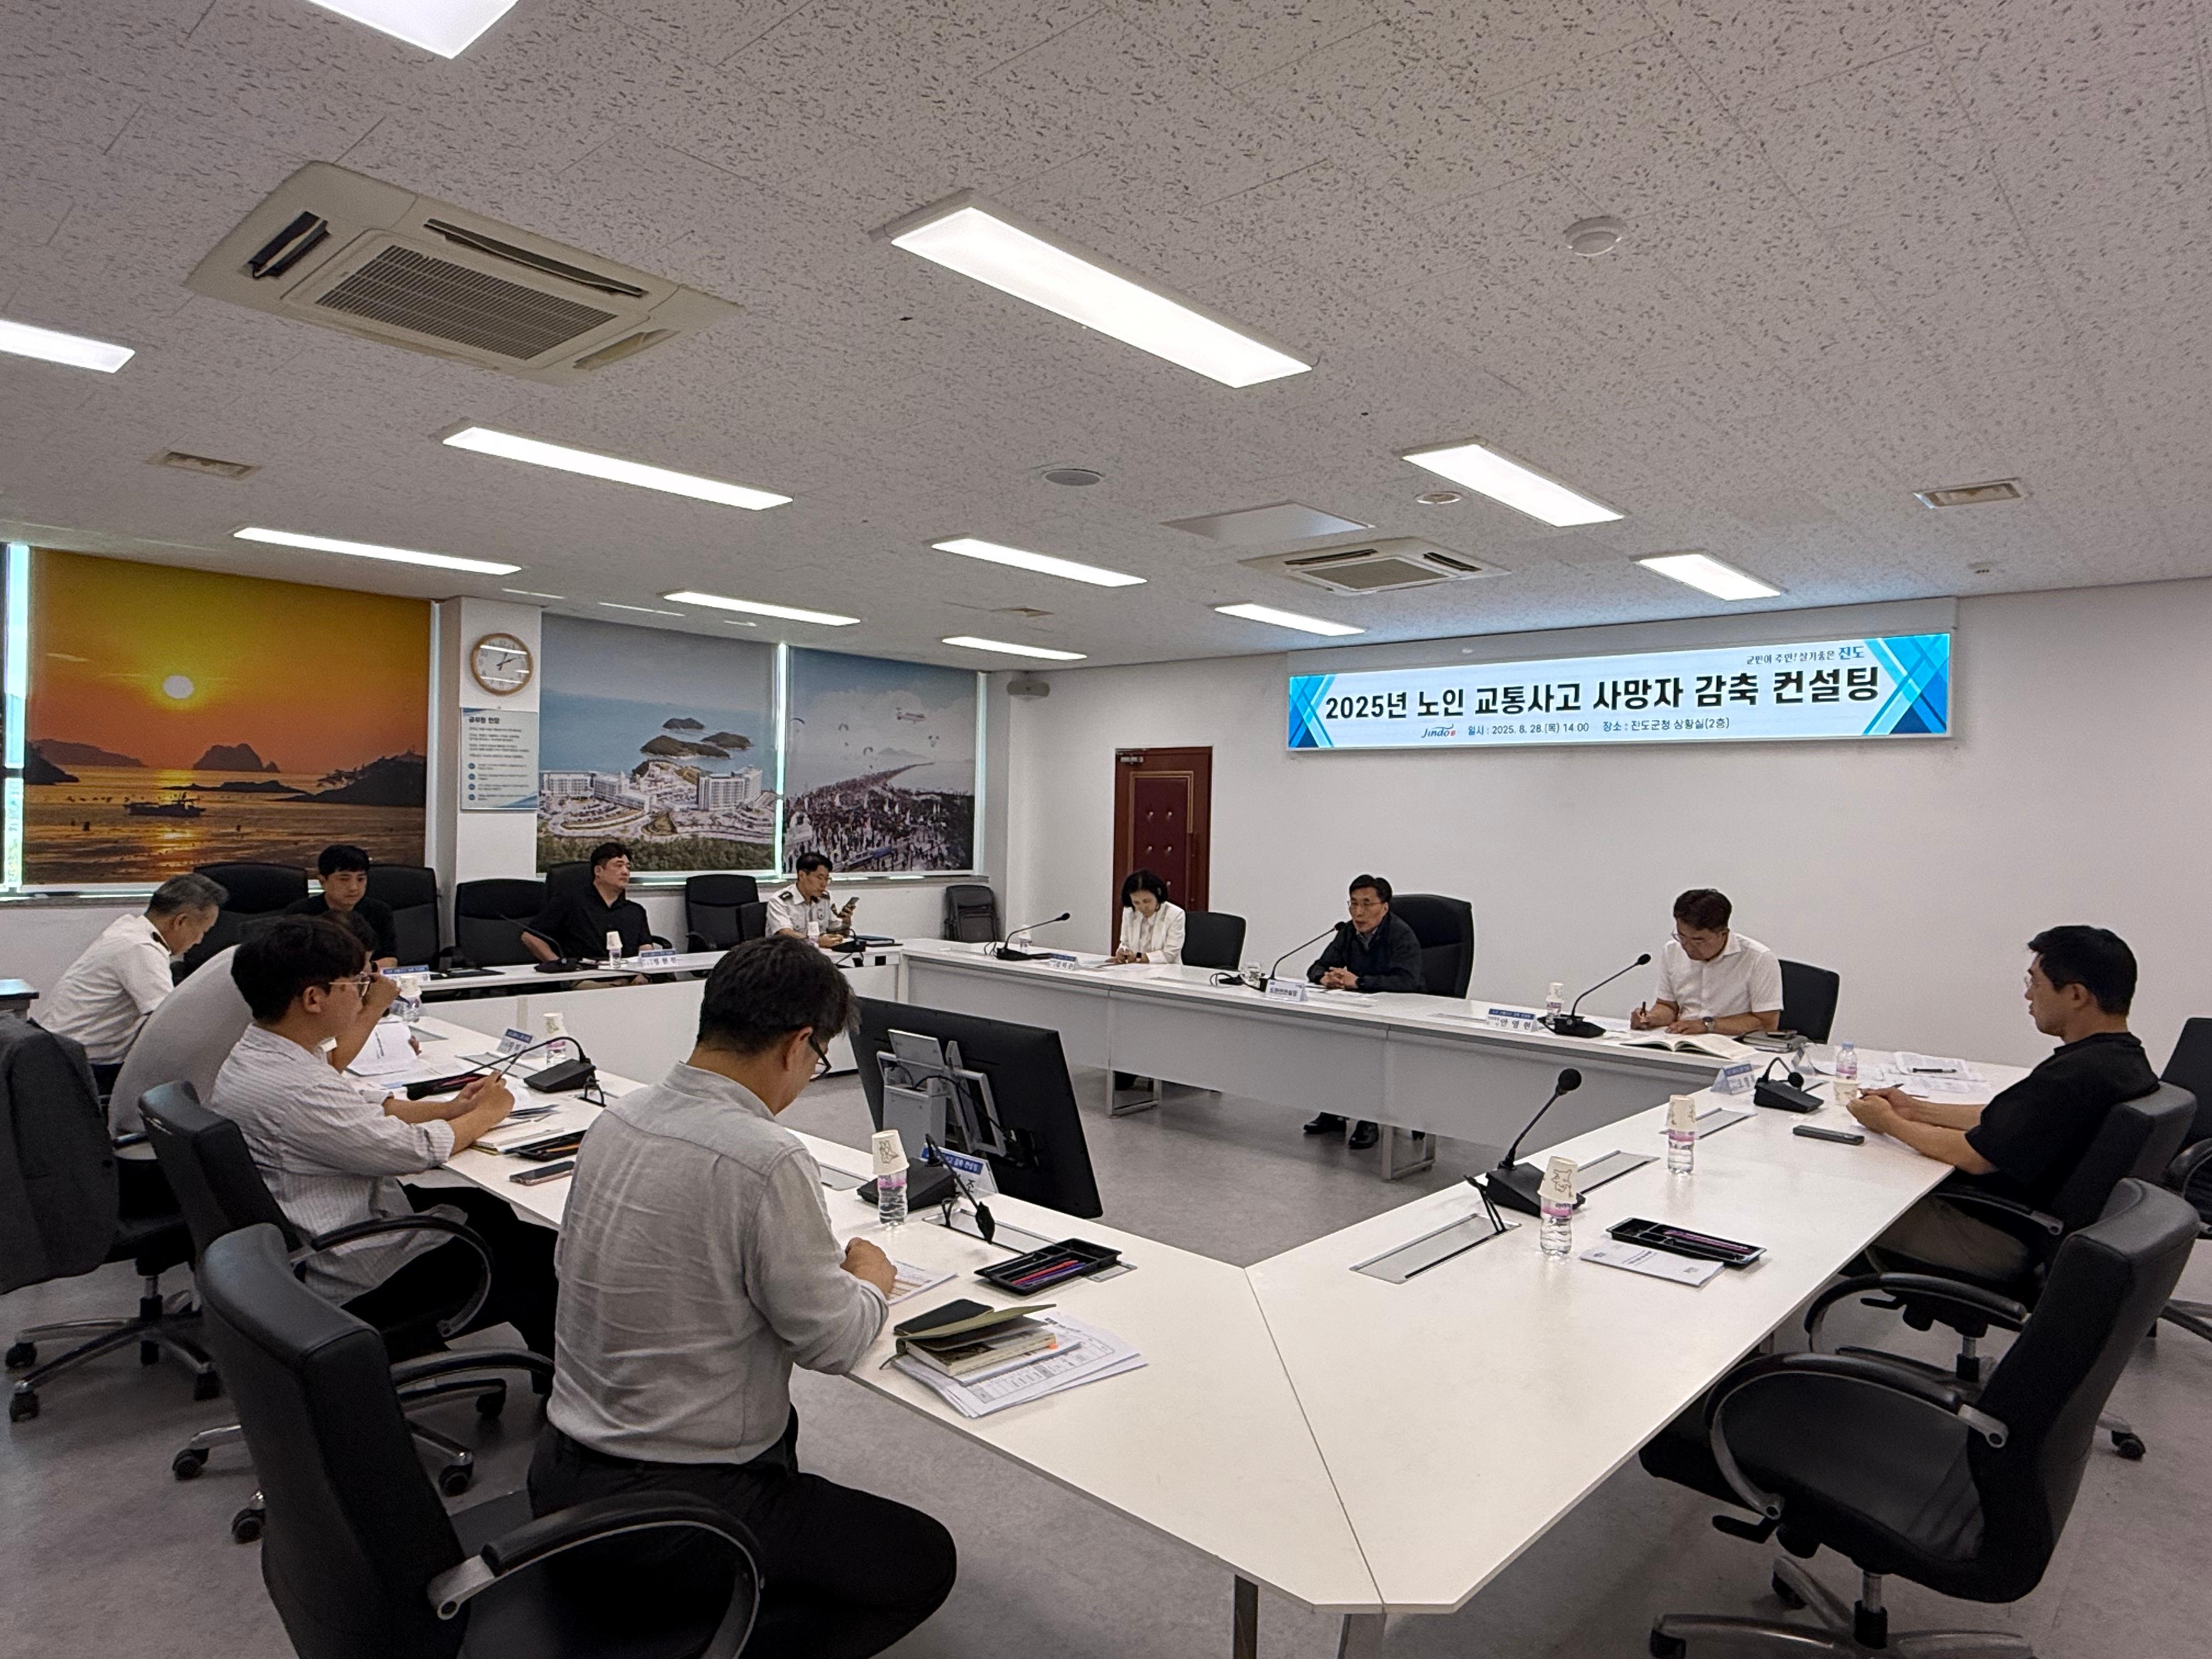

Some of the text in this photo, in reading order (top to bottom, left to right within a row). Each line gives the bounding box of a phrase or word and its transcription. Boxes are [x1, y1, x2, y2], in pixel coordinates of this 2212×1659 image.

[1838, 646, 1865, 660] 진도
[1325, 667, 1878, 719] 2025년 노인 교통사고 사망자 감축 컨설팅
[1492, 725, 1516, 735] 2025.
[1563, 722, 1589, 732] 14:00
[1602, 720, 1622, 732] 장소
[1631, 719, 1671, 731] 진도군청
